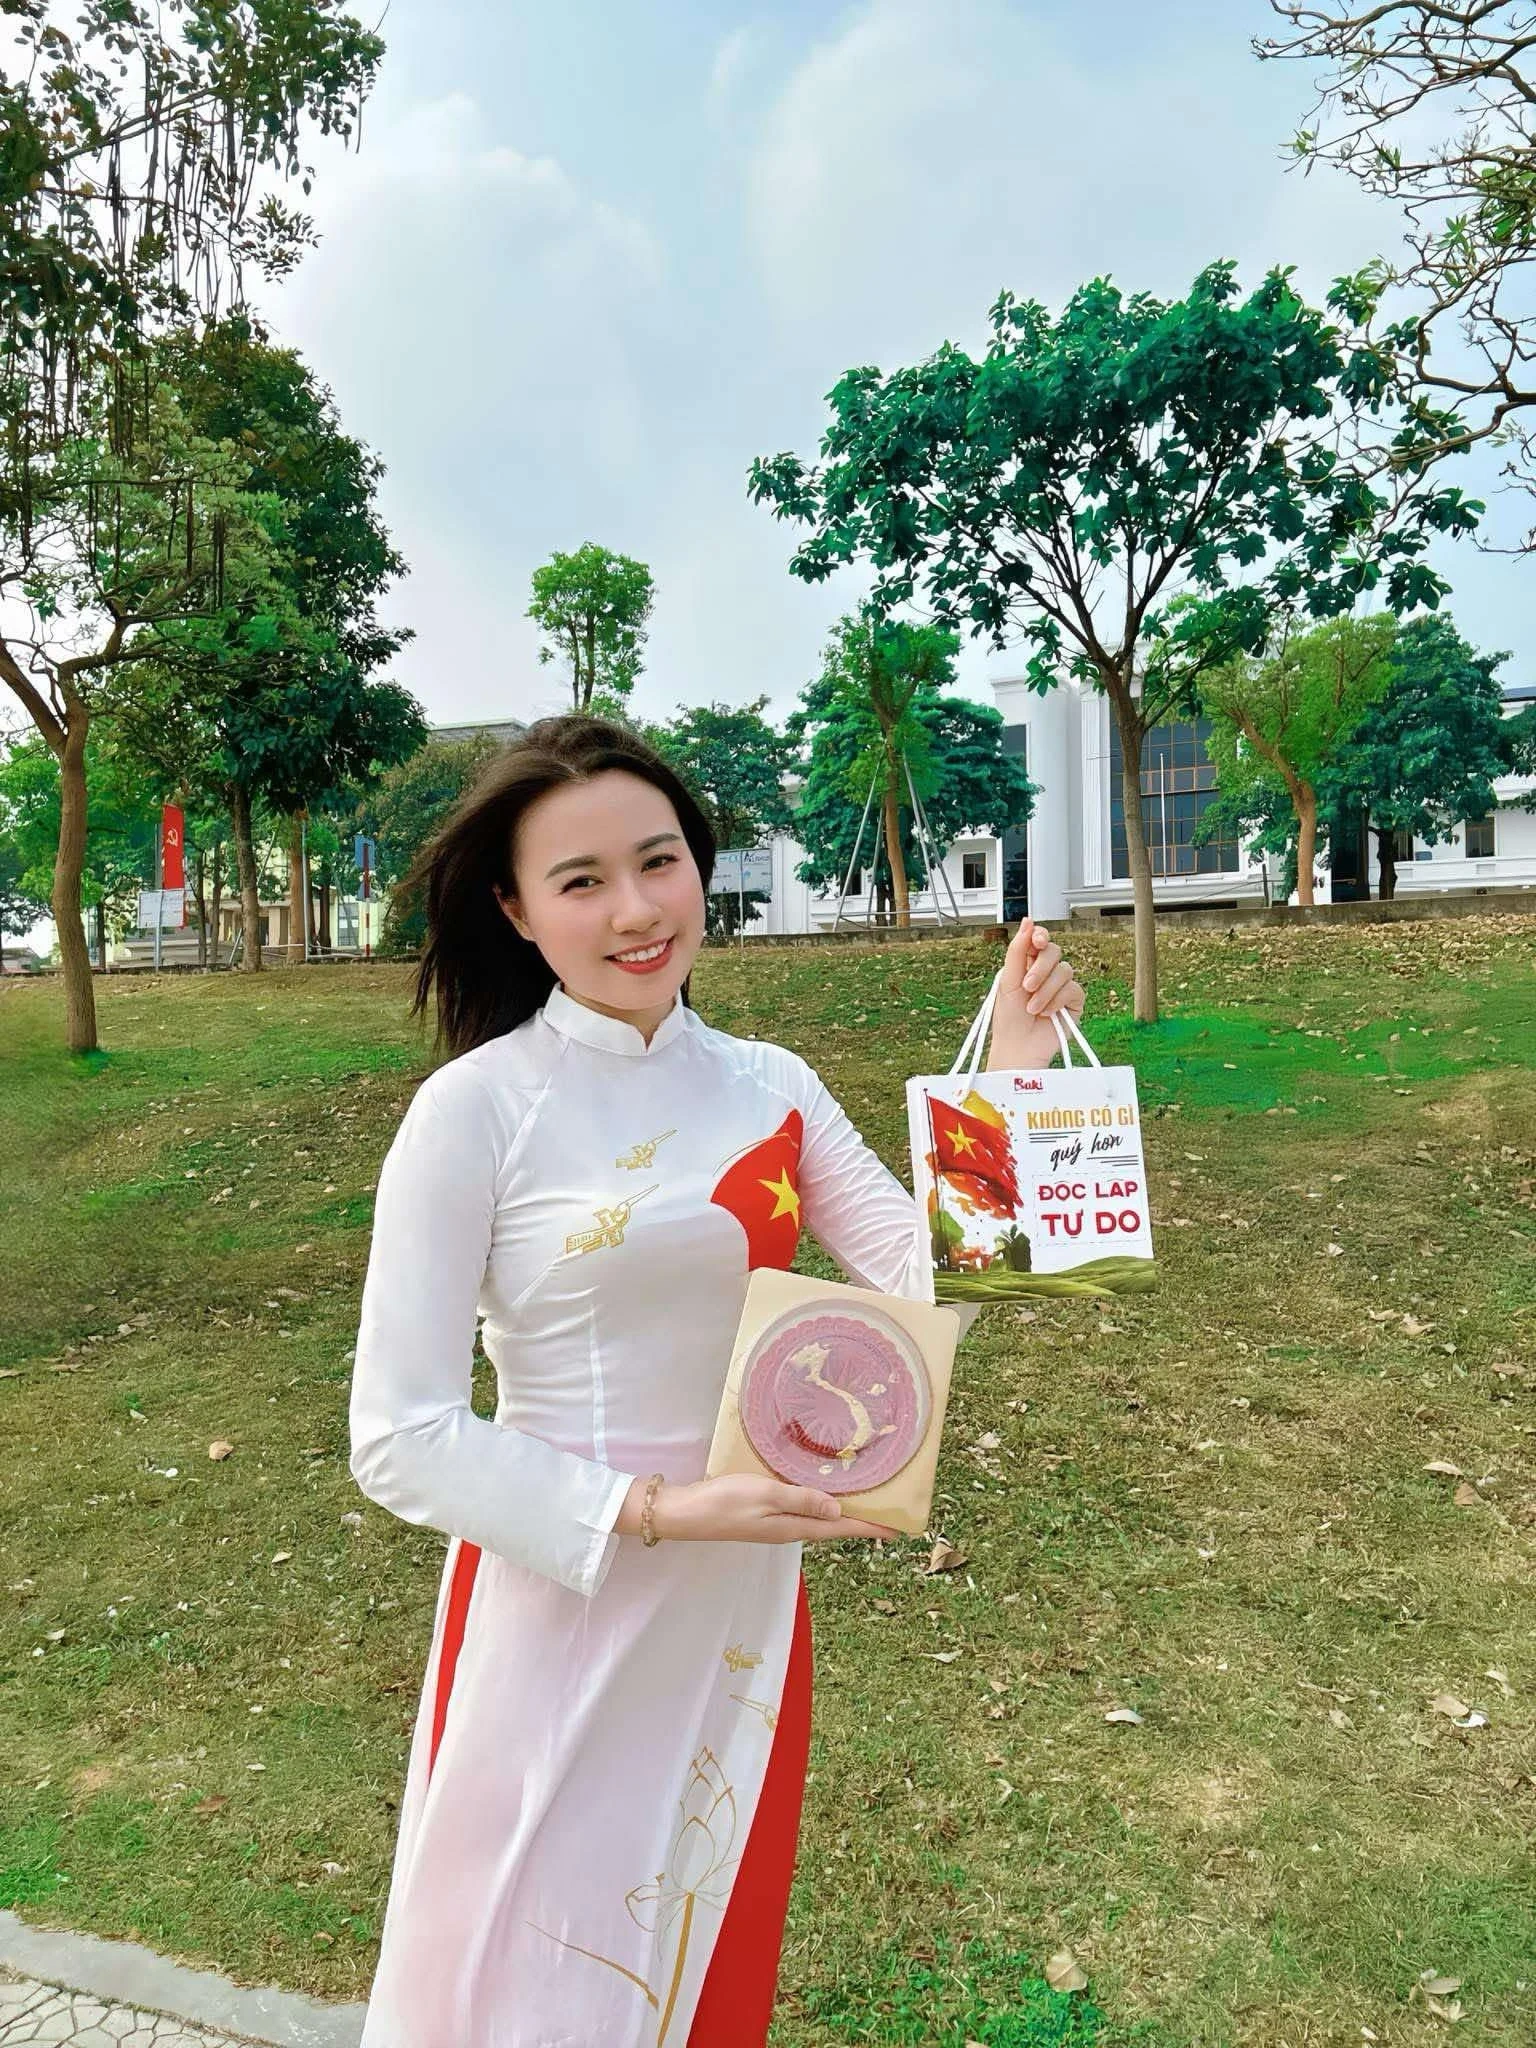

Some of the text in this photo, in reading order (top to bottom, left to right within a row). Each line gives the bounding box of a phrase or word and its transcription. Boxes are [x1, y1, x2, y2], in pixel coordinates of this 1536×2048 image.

[1027, 1106, 1085, 1129] KHÔNG
[1050, 1138, 1082, 1171] quý
[1095, 1210, 1140, 1234] DO
